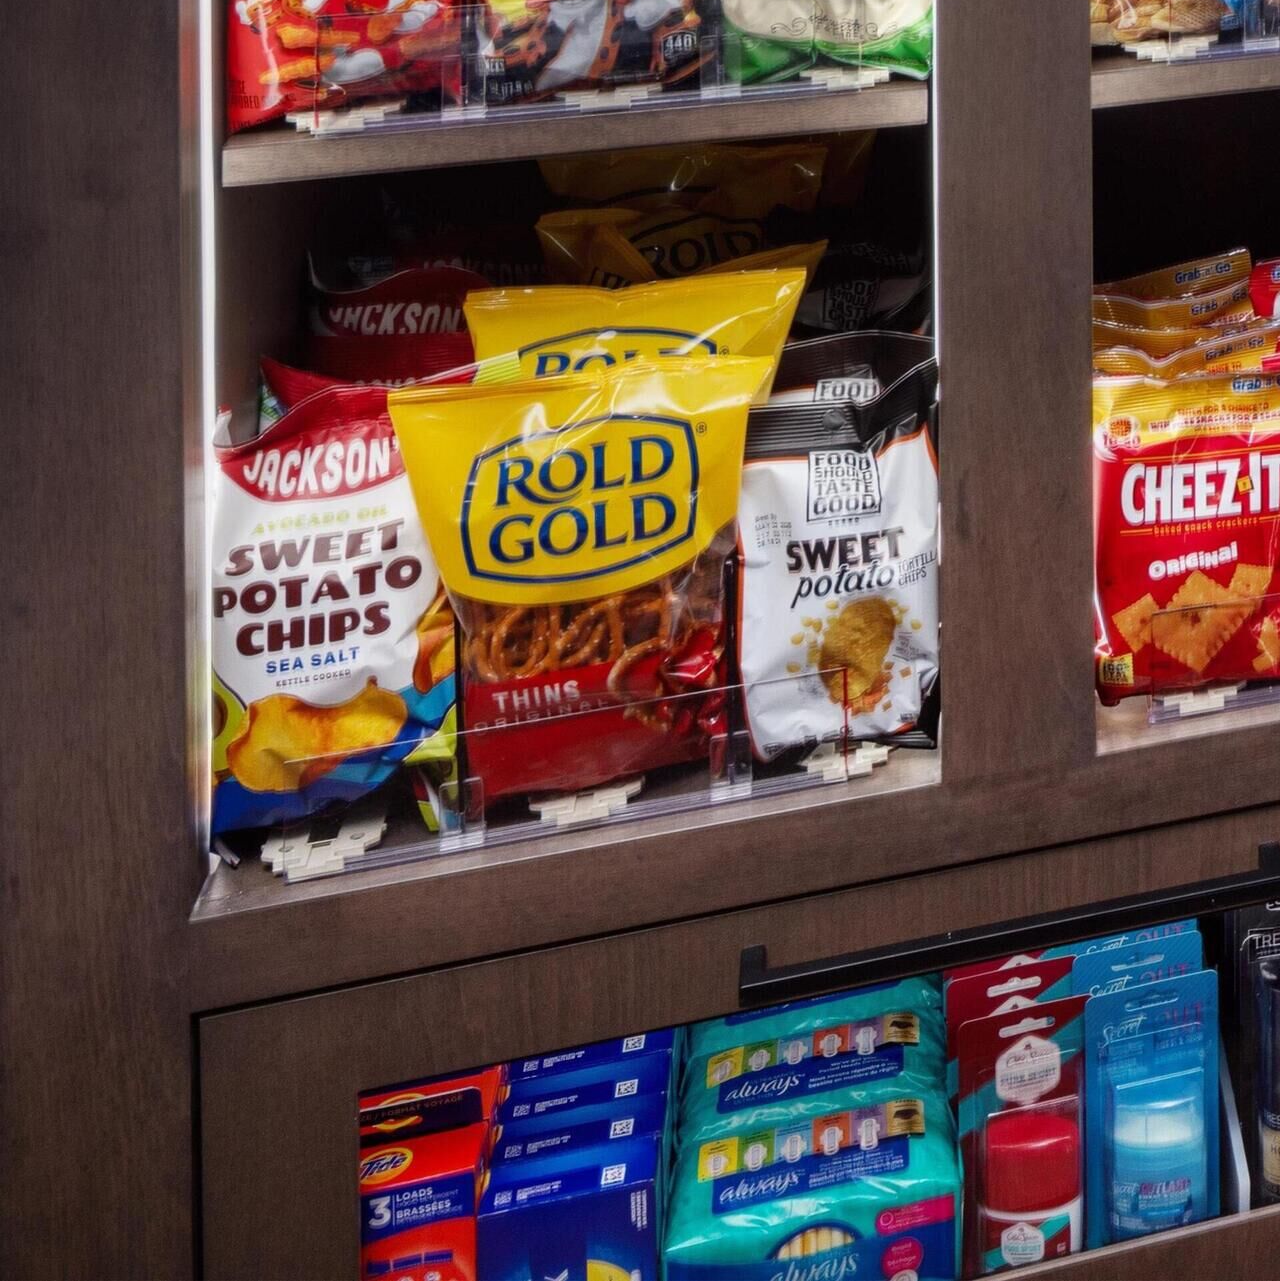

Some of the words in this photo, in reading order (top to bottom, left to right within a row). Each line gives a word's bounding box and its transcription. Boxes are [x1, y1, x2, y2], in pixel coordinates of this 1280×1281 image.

[819, 380, 878, 399] FOOD
[243, 437, 400, 498] JACKSON'
[496, 432, 675, 508] ROLD
[815, 451, 871, 471] FOOD
[815, 477, 874, 496] TASTE
[251, 511, 349, 537] AVOCADO
[489, 491, 678, 565] GOLD
[225, 519, 405, 577] SWEET
[786, 526, 904, 573] SWEET
[213, 555, 422, 617] POTATO
[791, 560, 894, 609] potato
[898, 567, 927, 586] CHIPS
[236, 601, 391, 656] CHIPS
[266, 657, 304, 674] SEA
[311, 646, 360, 666] SALT
[276, 675, 310, 688] KETTLE
[313, 669, 351, 682] COOKED
[491, 680, 582, 711] THINS
[725, 1072, 801, 1101] always
[361, 1153, 408, 1180] Tide
[720, 1171, 800, 1205] always
[368, 1195, 392, 1230] 3
[396, 1187, 433, 1202] LOADS
[396, 1199, 451, 1219] BRASSÉES
